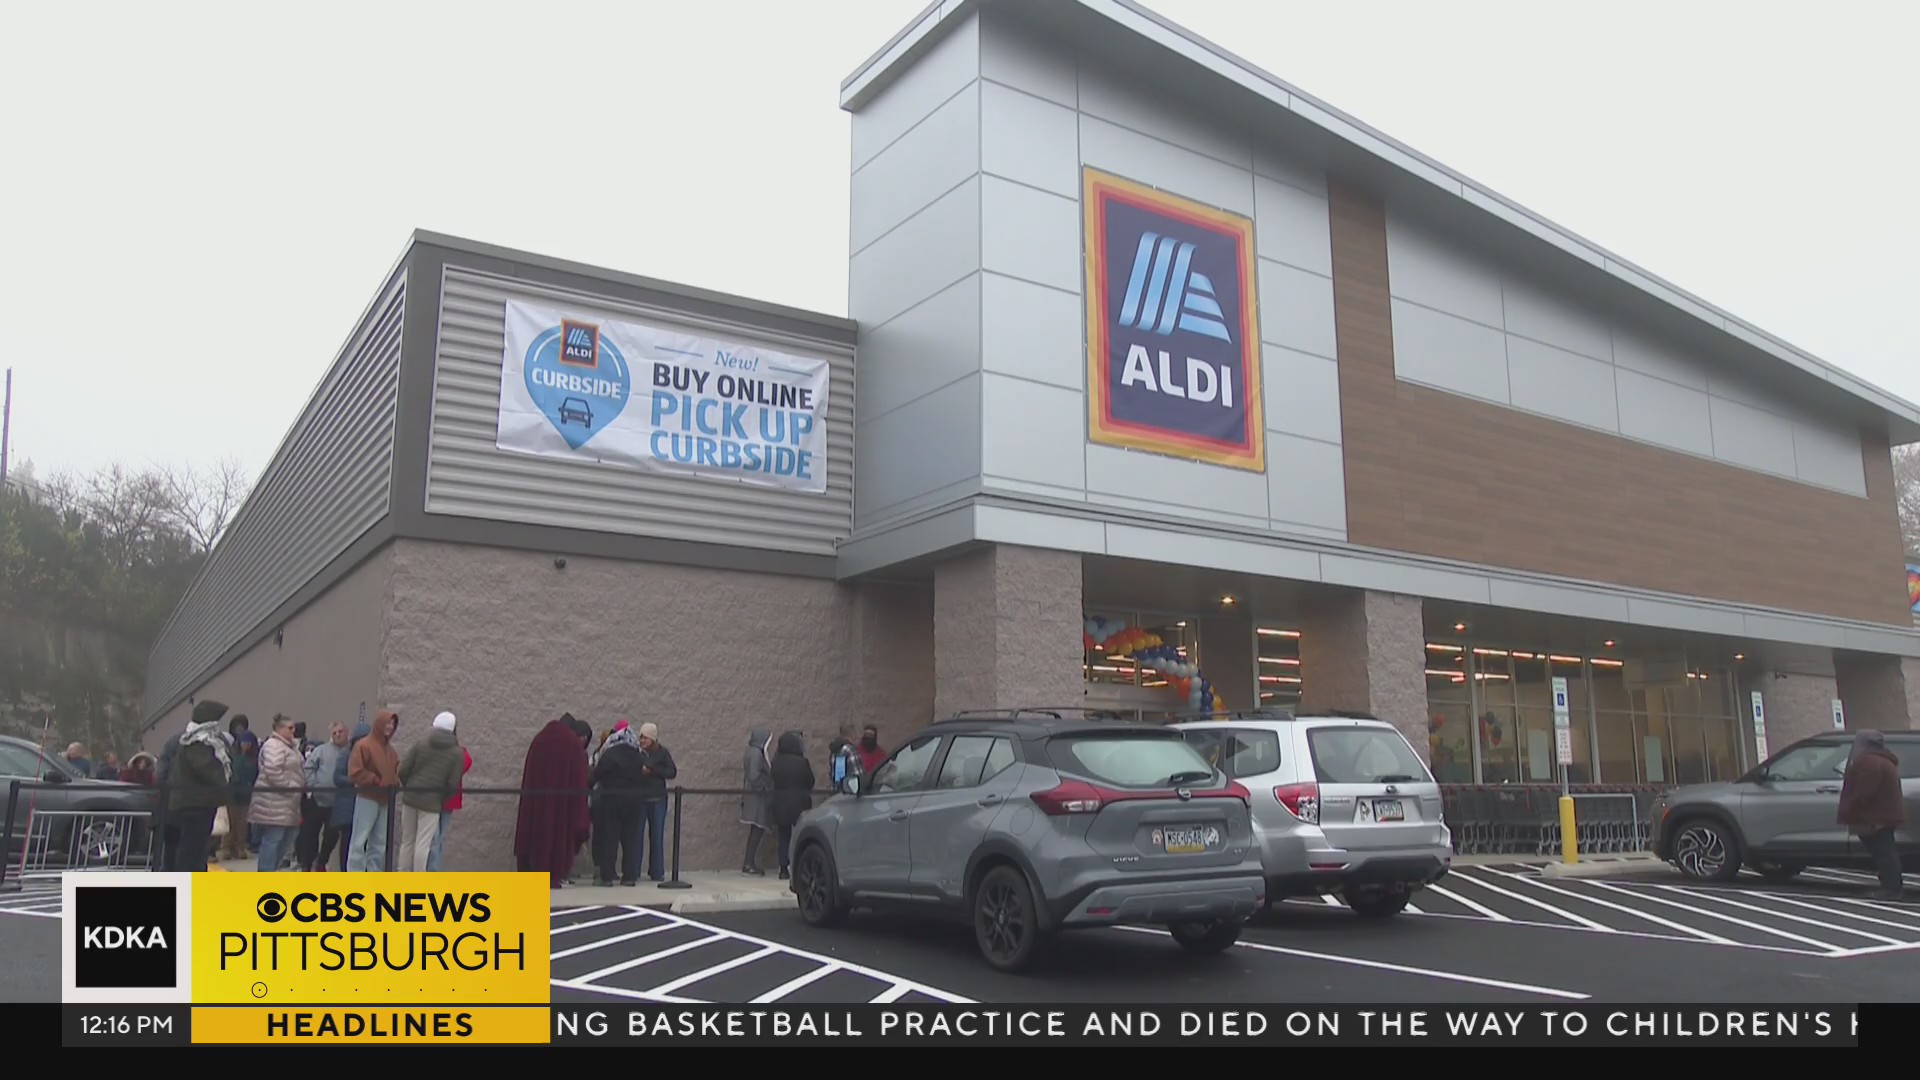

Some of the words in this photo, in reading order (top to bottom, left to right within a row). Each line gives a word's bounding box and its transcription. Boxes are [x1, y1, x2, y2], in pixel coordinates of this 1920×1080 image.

[565, 345, 594, 360] ALDI
[714, 350, 760, 372] New!
[1120, 343, 1234, 408] ALDI
[531, 366, 622, 399] CURBSIDE
[652, 362, 711, 395] BUY
[717, 374, 815, 411] ONLINE
[651, 390, 750, 440] PICK
[758, 407, 814, 446] UP
[650, 429, 813, 480] CURBSIDE
